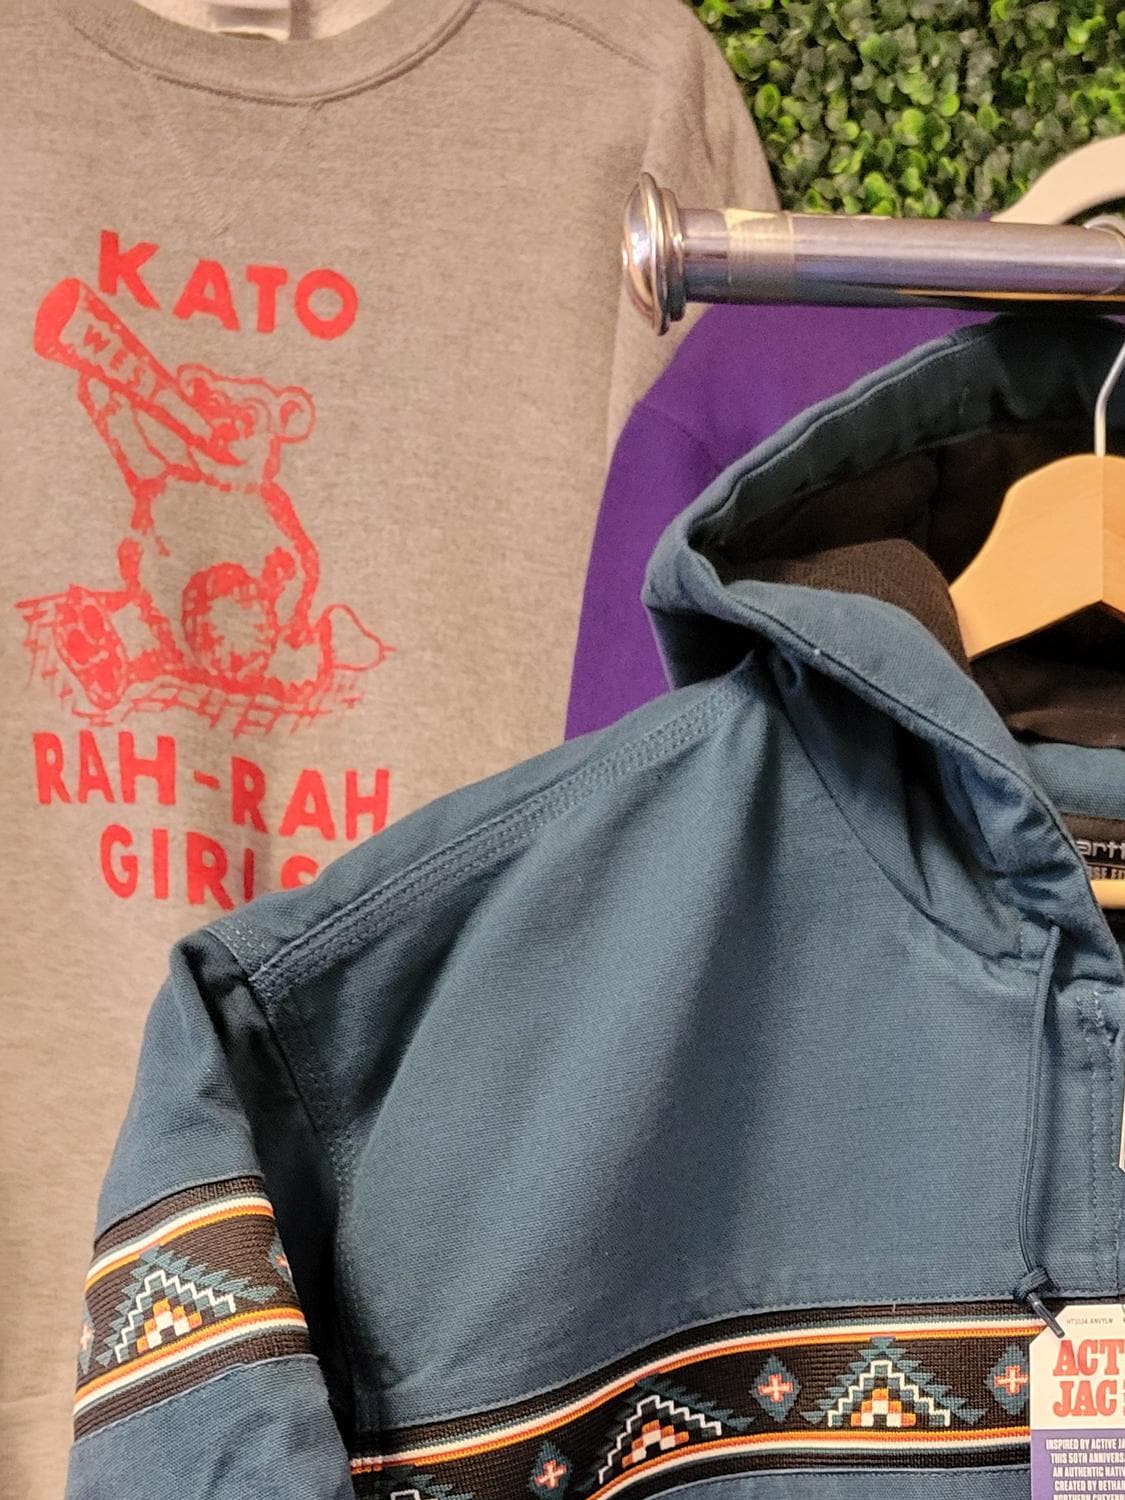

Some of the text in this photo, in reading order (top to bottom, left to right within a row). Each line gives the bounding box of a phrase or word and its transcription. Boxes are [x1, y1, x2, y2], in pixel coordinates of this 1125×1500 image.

[100, 230, 359, 340] KATO
[33, 730, 390, 841] RAH-RAH
[1053, 1379, 1118, 1418] JAC
[1046, 1438, 1078, 1449] INSPIRED
[1080, 1438, 1090, 1449] BY
[1091, 1438, 1117, 1449] ACTIVE
[1051, 1453, 1067, 1463] THIS
[1069, 1453, 1087, 1463] 50TH
[1053, 1467, 1063, 1477] AN
[1065, 1467, 1104, 1477] AUTHENTIC
[1055, 1480, 1086, 1491] CREATED
[1087, 1480, 1097, 1491] BY
